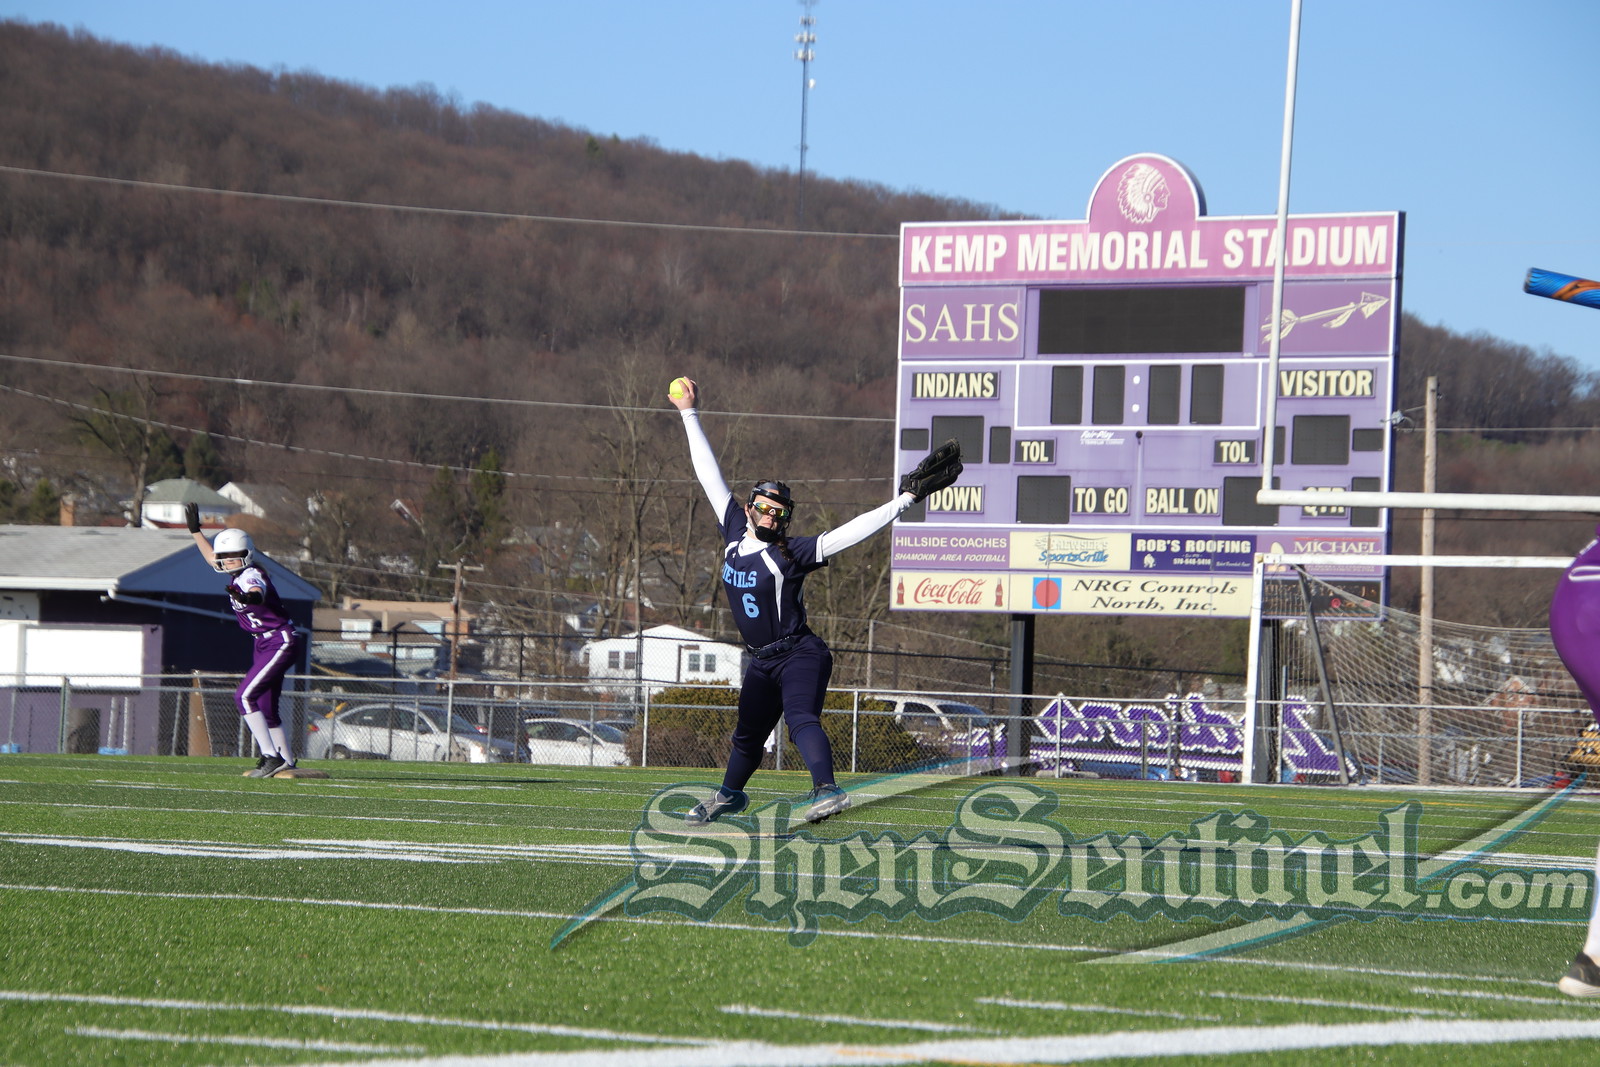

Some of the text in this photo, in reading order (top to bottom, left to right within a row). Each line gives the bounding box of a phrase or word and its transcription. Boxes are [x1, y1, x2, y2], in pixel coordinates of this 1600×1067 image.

[911, 225, 1388, 273] KEMP MEMORIAL STADIUM
[905, 302, 1019, 343] SAHS
[916, 372, 995, 398] INDIANS
[1280, 370, 1373, 396] VISITOR
[1021, 441, 1049, 462] TOL
[1220, 441, 1250, 463] TOL
[929, 486, 982, 512] DOWN
[1075, 487, 1127, 513] TO GO
[1146, 488, 1219, 514] BALL ON
[895, 536, 1007, 548] HILLSIDE COACHES
[1136, 538, 1251, 554] ROB'S ROOFING
[1293, 541, 1381, 554] MICHAEL
[894, 553, 1006, 563] SHAMOKIN AREA FOOTBALL
[914, 577, 987, 605] Coca-Cola
[1073, 579, 1238, 595] NRG Controls
[742, 593, 759, 618] 6
[1091, 596, 1217, 611] North, Inc.
